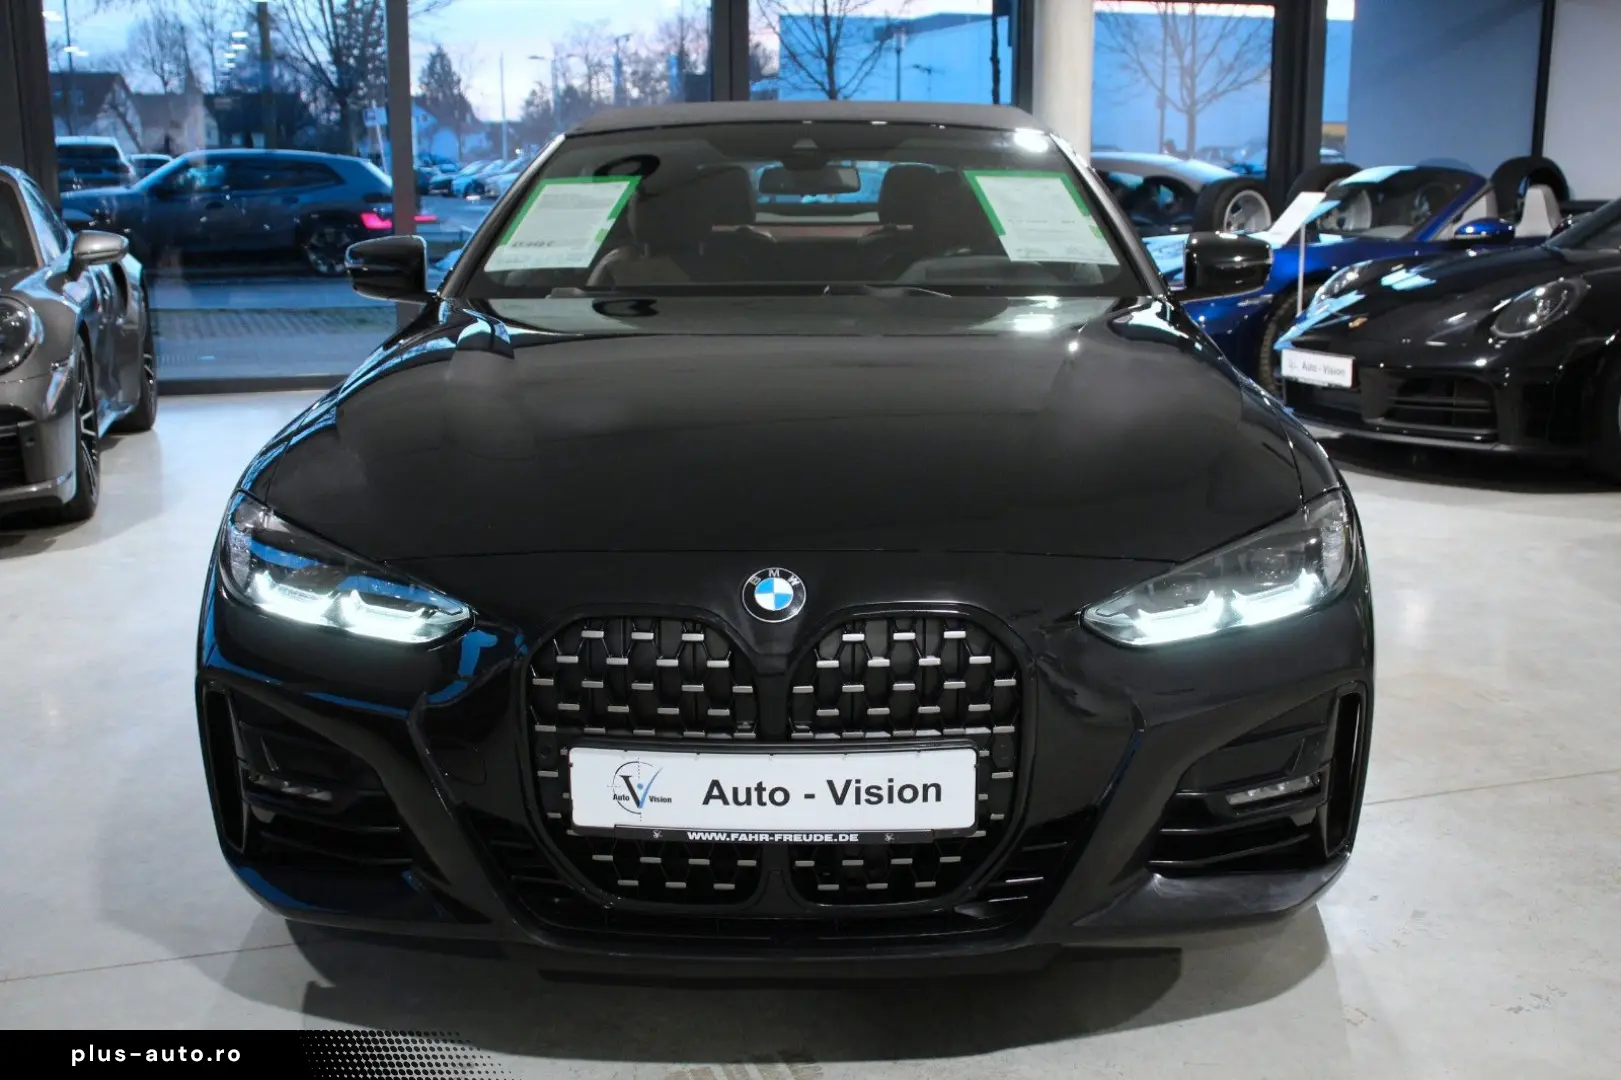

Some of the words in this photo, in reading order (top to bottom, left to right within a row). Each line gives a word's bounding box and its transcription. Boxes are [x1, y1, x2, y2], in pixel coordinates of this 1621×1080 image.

[749, 568, 801, 586] BMW
[649, 795, 672, 803] Vision
[702, 779, 790, 806] Auto
[827, 778, 942, 806] Vision
[687, 831, 859, 842] WWW.FAHR-FREUDE.DE
